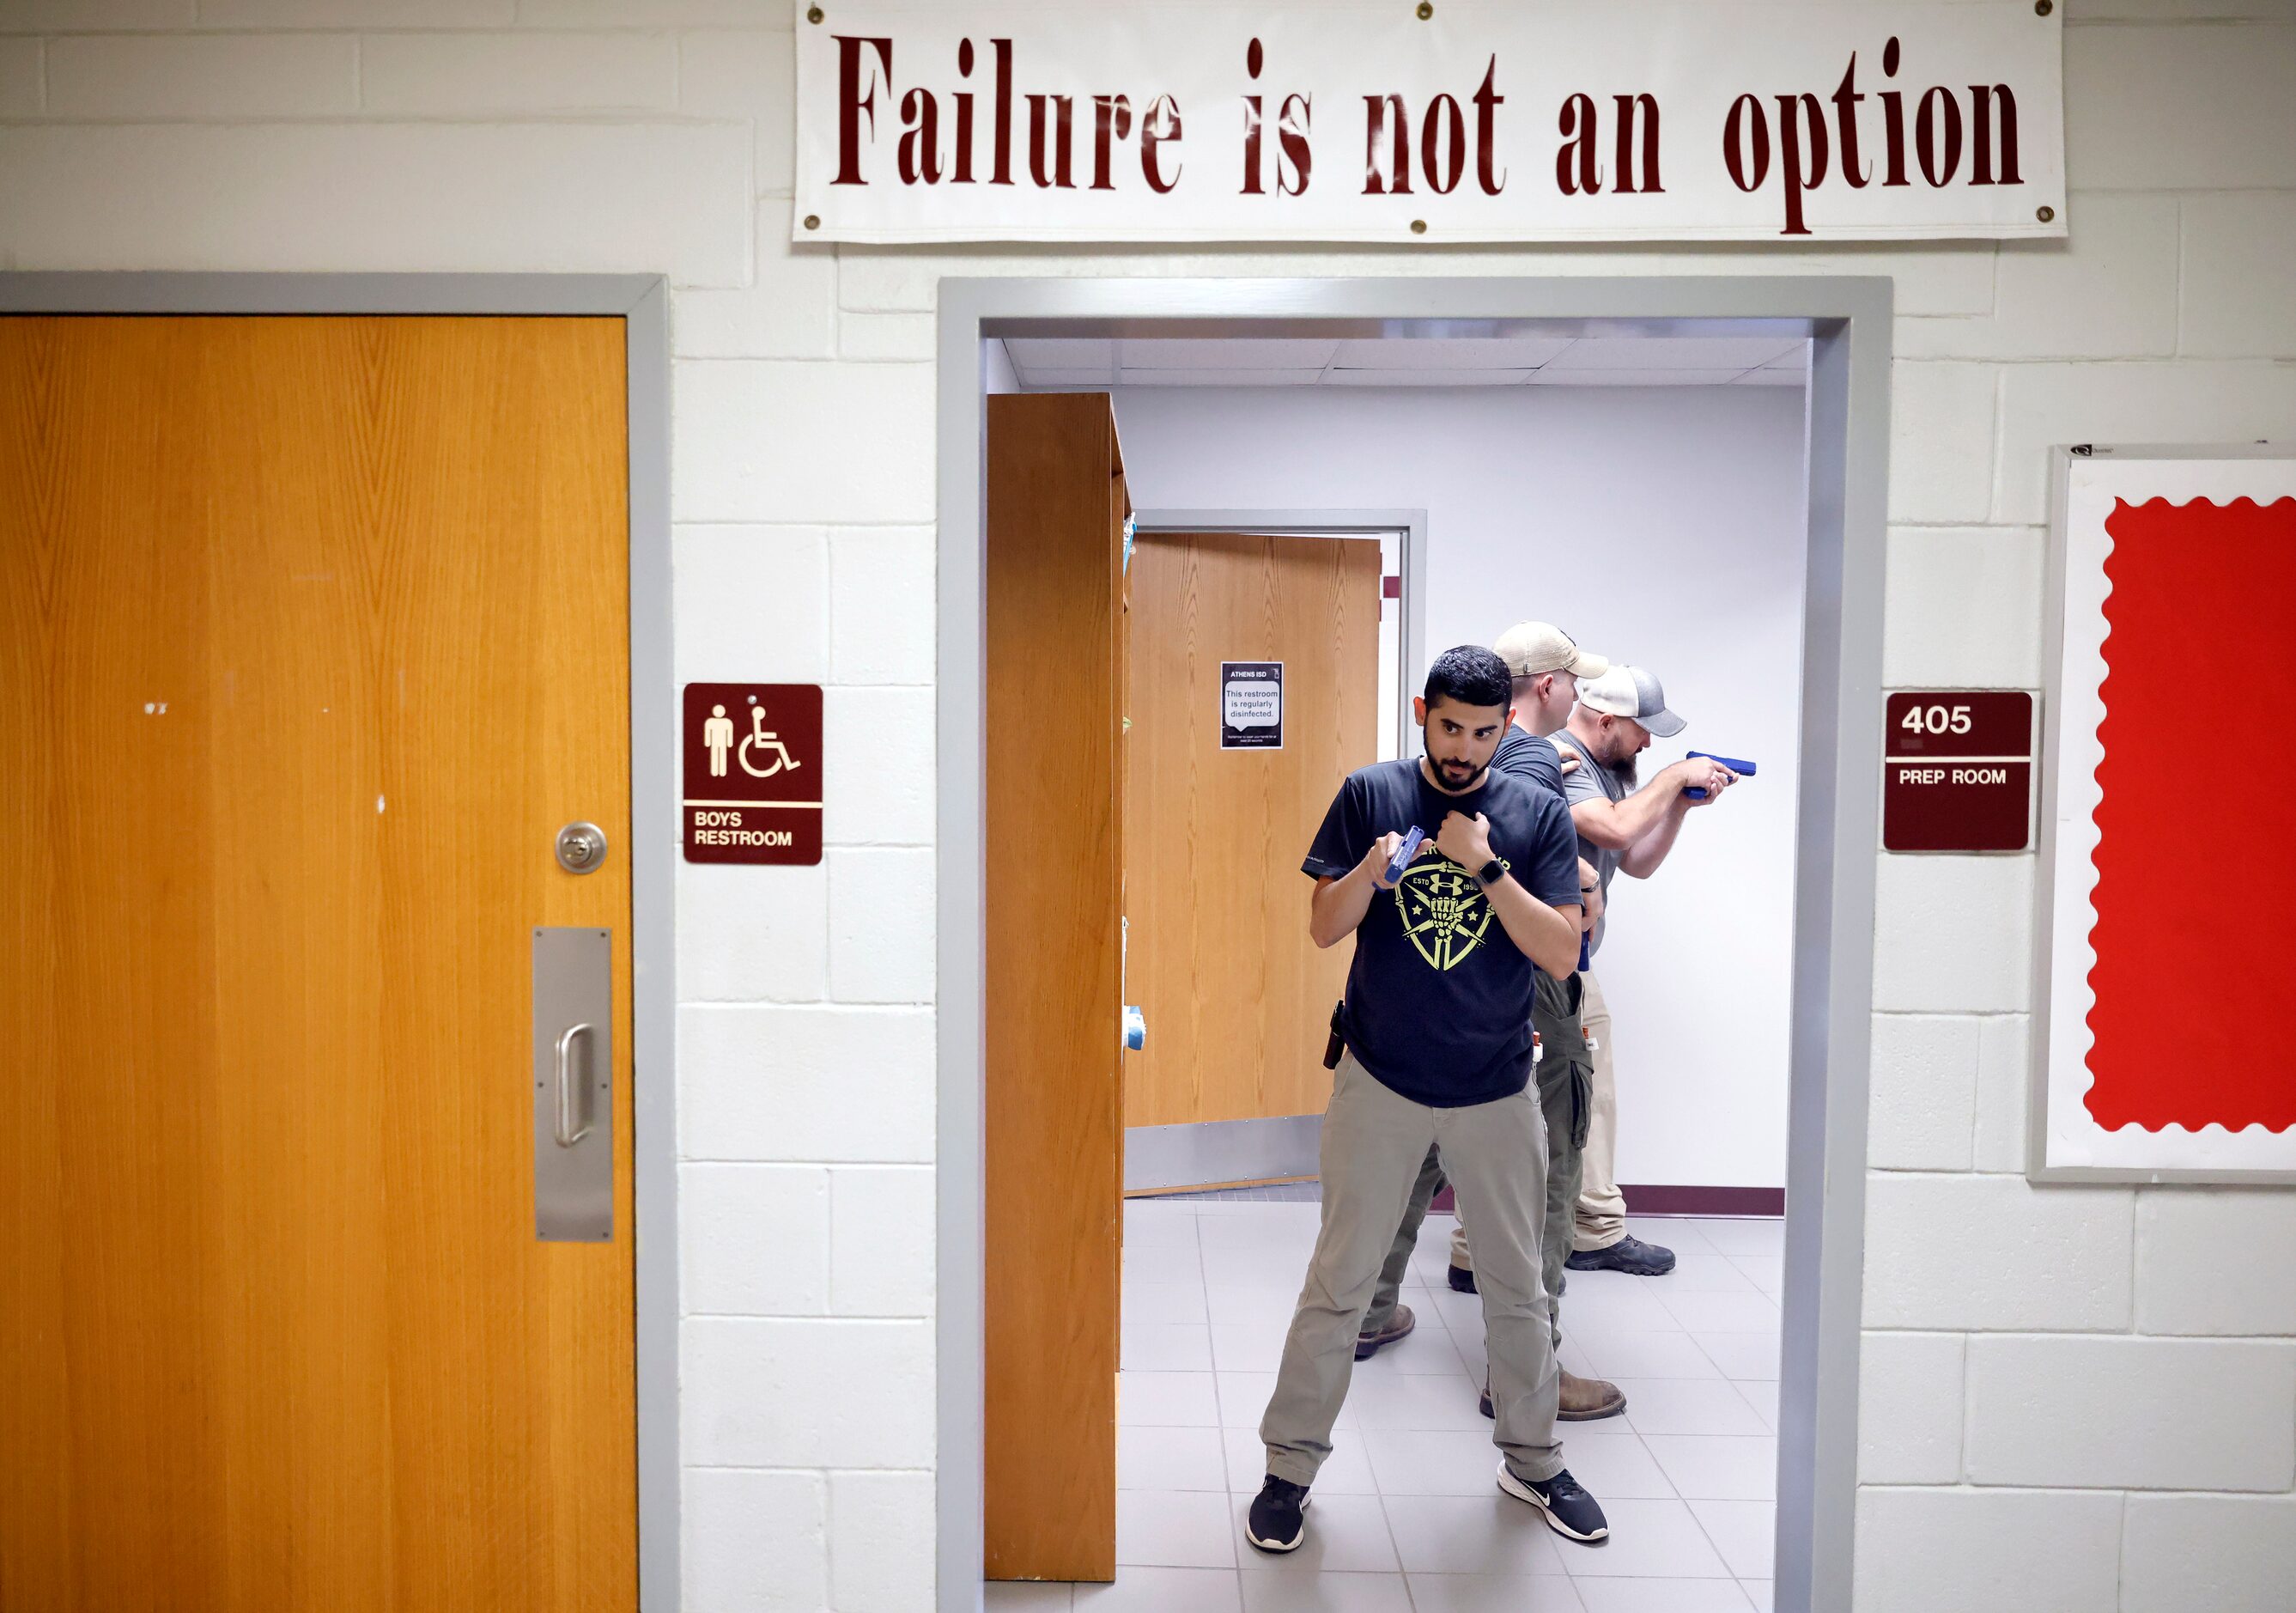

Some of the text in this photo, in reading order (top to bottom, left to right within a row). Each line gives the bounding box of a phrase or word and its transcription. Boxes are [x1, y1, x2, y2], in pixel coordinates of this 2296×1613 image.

[830, 36, 2024, 234] Failure is not an option
[1240, 700, 1273, 709] regularly
[1902, 706, 1971, 733] 405
[1899, 770, 2006, 785] PREP ROOM
[695, 812, 742, 827] BOYS
[695, 831, 792, 846] RESTROOM
[1412, 877, 1430, 886] ESTD
